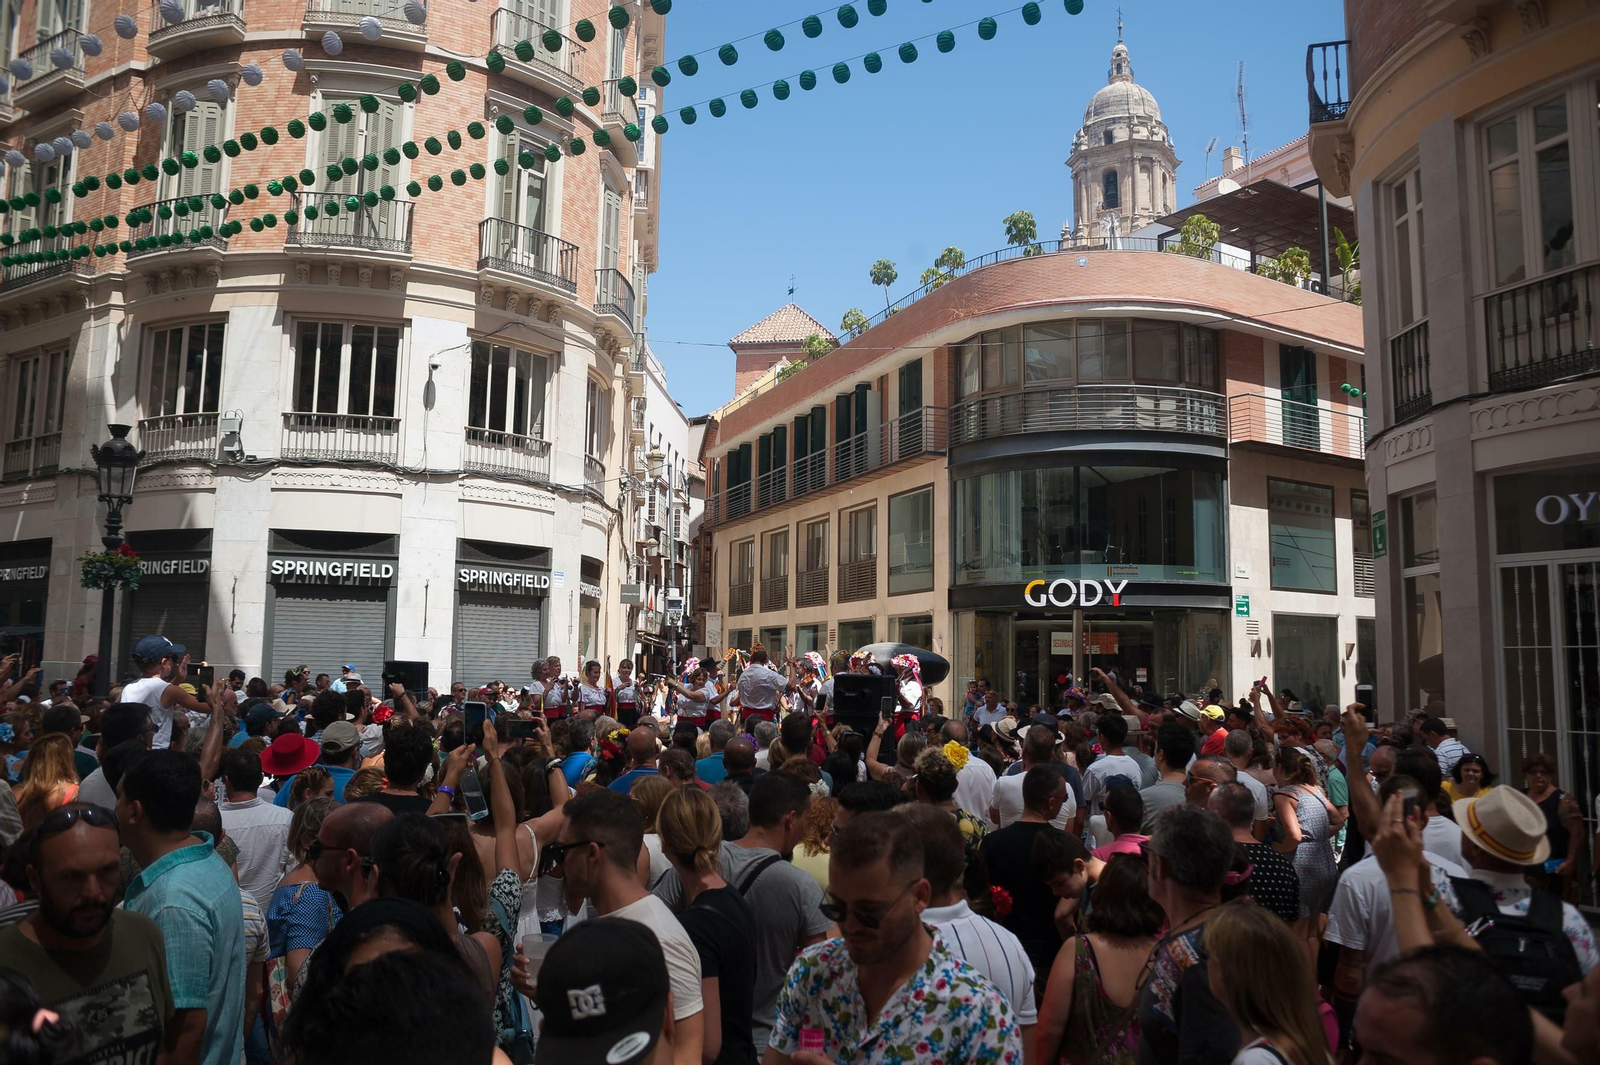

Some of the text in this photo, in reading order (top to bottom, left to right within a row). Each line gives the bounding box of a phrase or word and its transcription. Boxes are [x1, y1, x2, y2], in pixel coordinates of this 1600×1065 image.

[1535, 492, 1600, 525] OY
[138, 559, 208, 575] RINGFIELD
[271, 559, 393, 578] SPRINGFIELD
[459, 568, 549, 589] SPRINGFIELD
[1024, 578, 1129, 607] GODY
